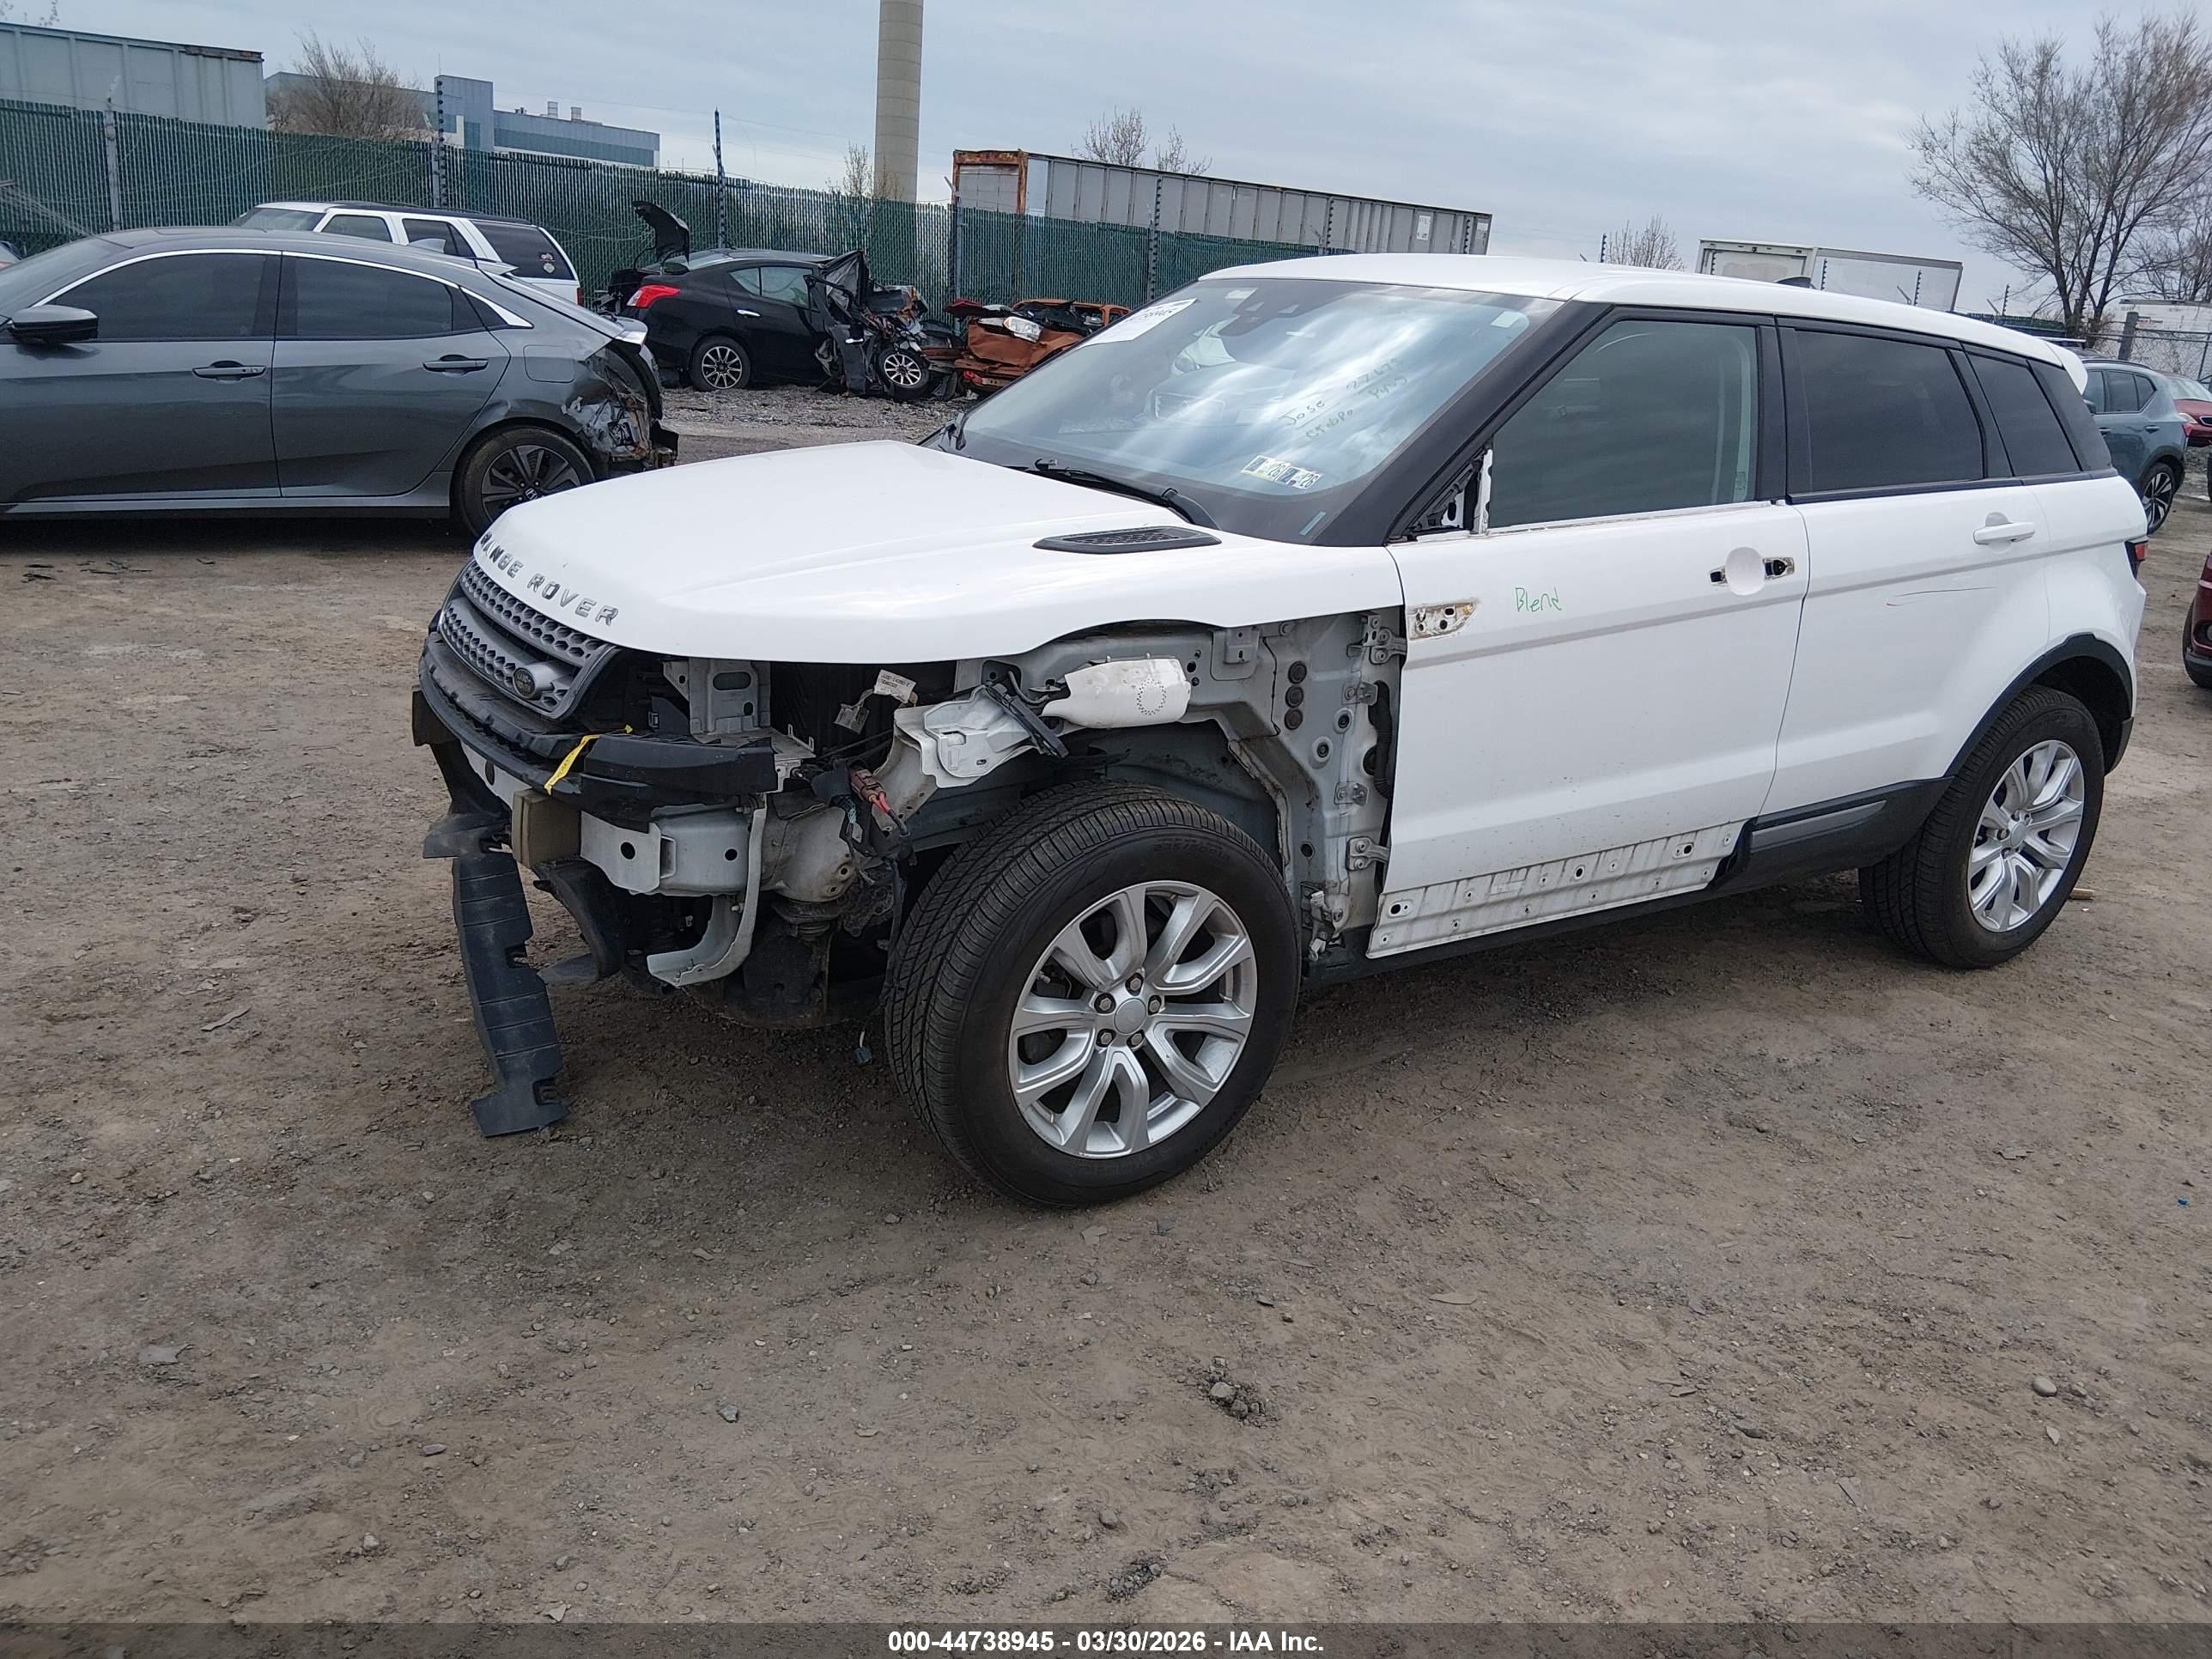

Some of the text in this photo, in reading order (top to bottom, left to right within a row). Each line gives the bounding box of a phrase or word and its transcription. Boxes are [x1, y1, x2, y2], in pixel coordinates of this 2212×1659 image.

[480, 531, 619, 627] RANGE ROVER
[1515, 585, 1563, 613] Blend
